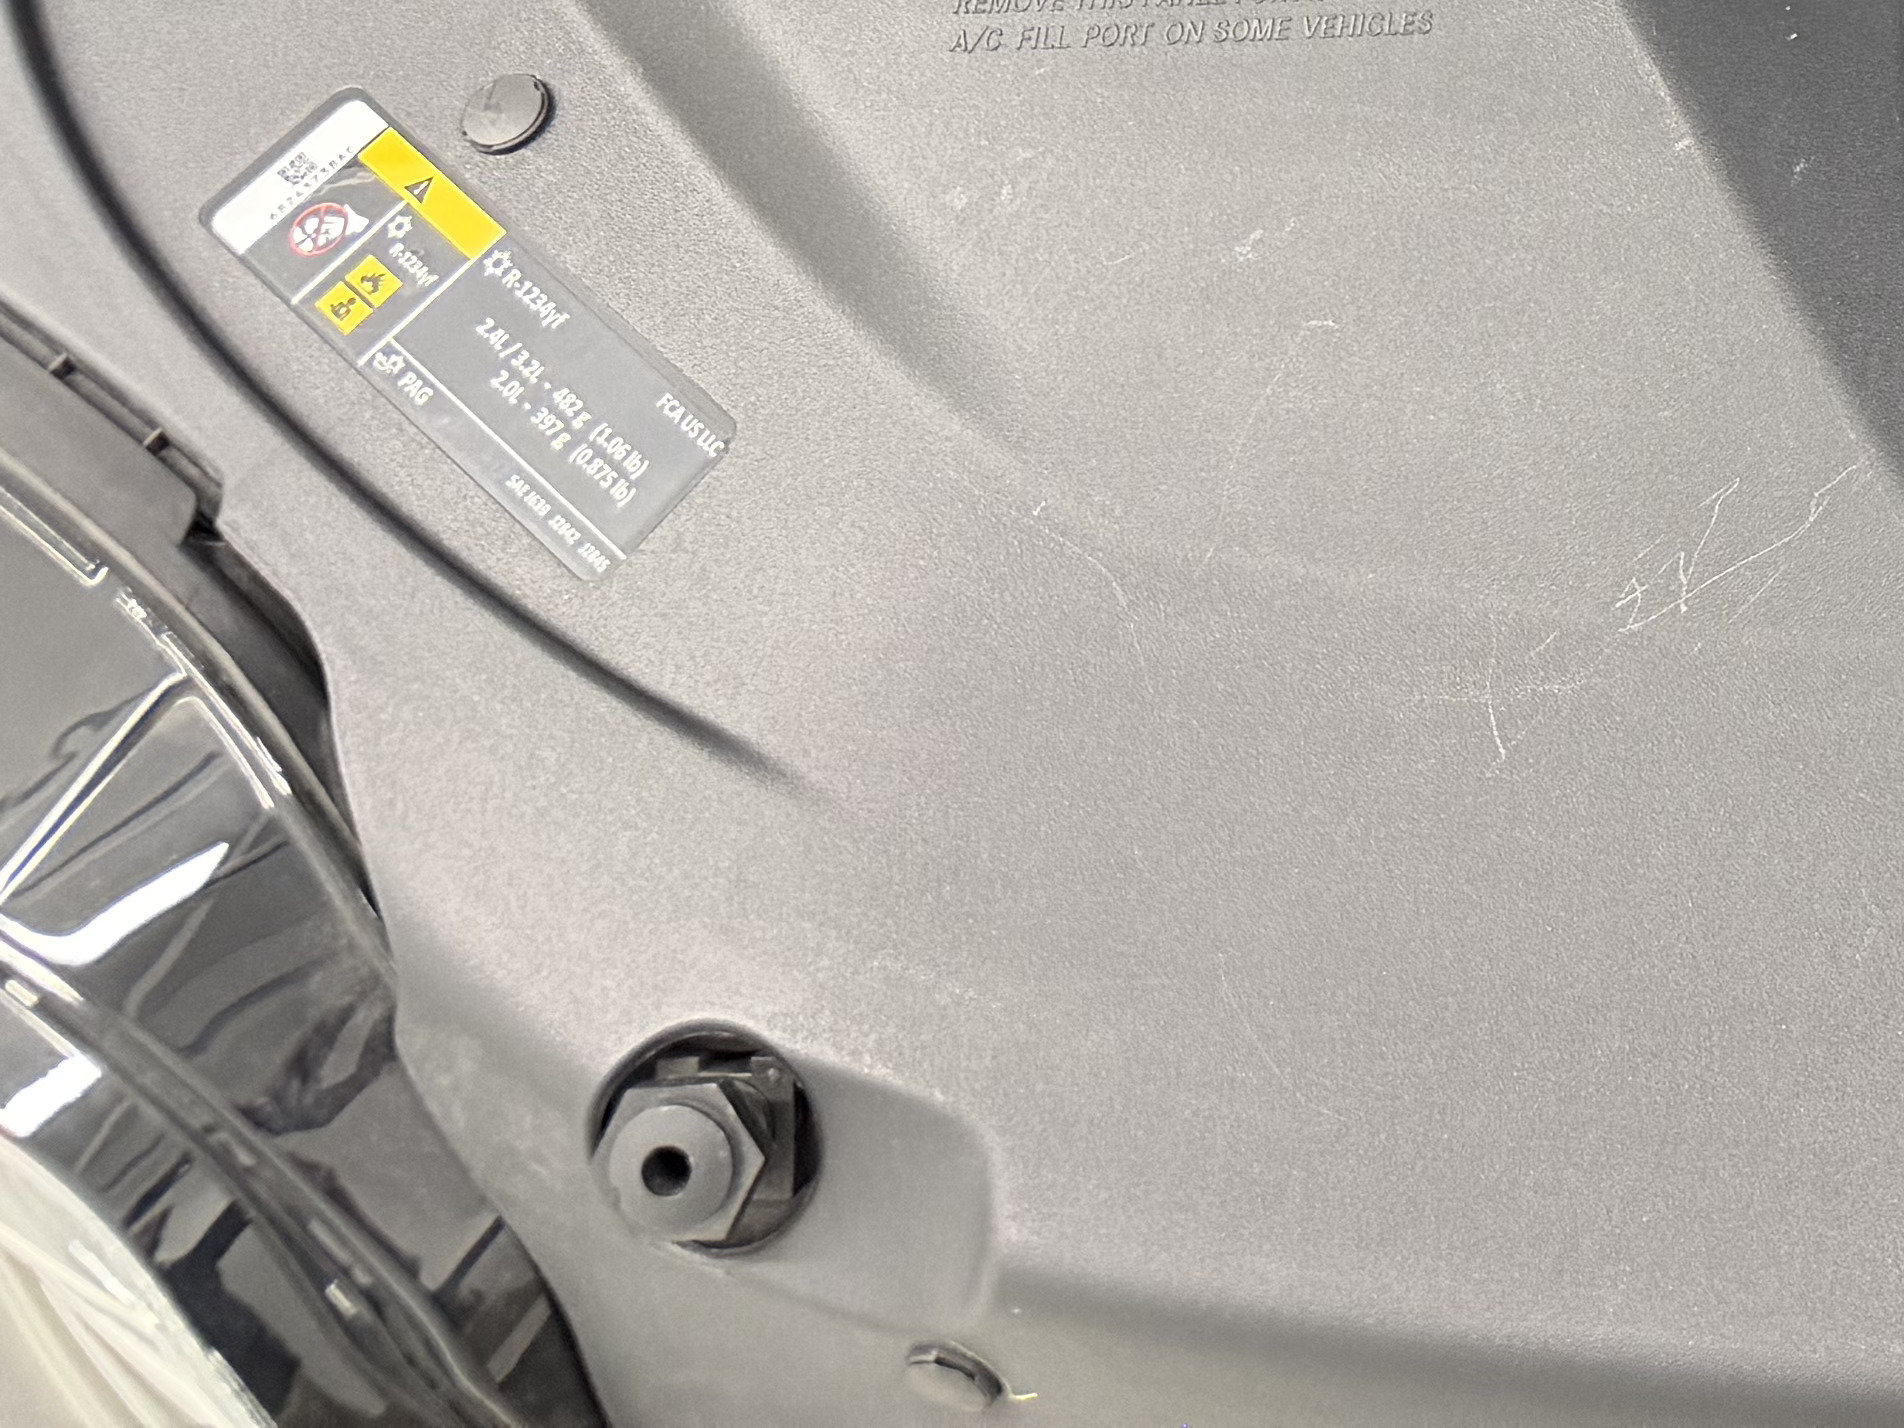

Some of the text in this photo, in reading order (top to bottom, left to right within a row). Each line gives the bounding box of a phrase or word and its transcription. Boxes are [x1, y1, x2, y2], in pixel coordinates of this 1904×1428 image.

[948, 8, 1435, 55] A/C FILL PORT ON SOME VEHICLES
[501, 269, 570, 331] R-1234yf
[395, 369, 435, 408] PAG
